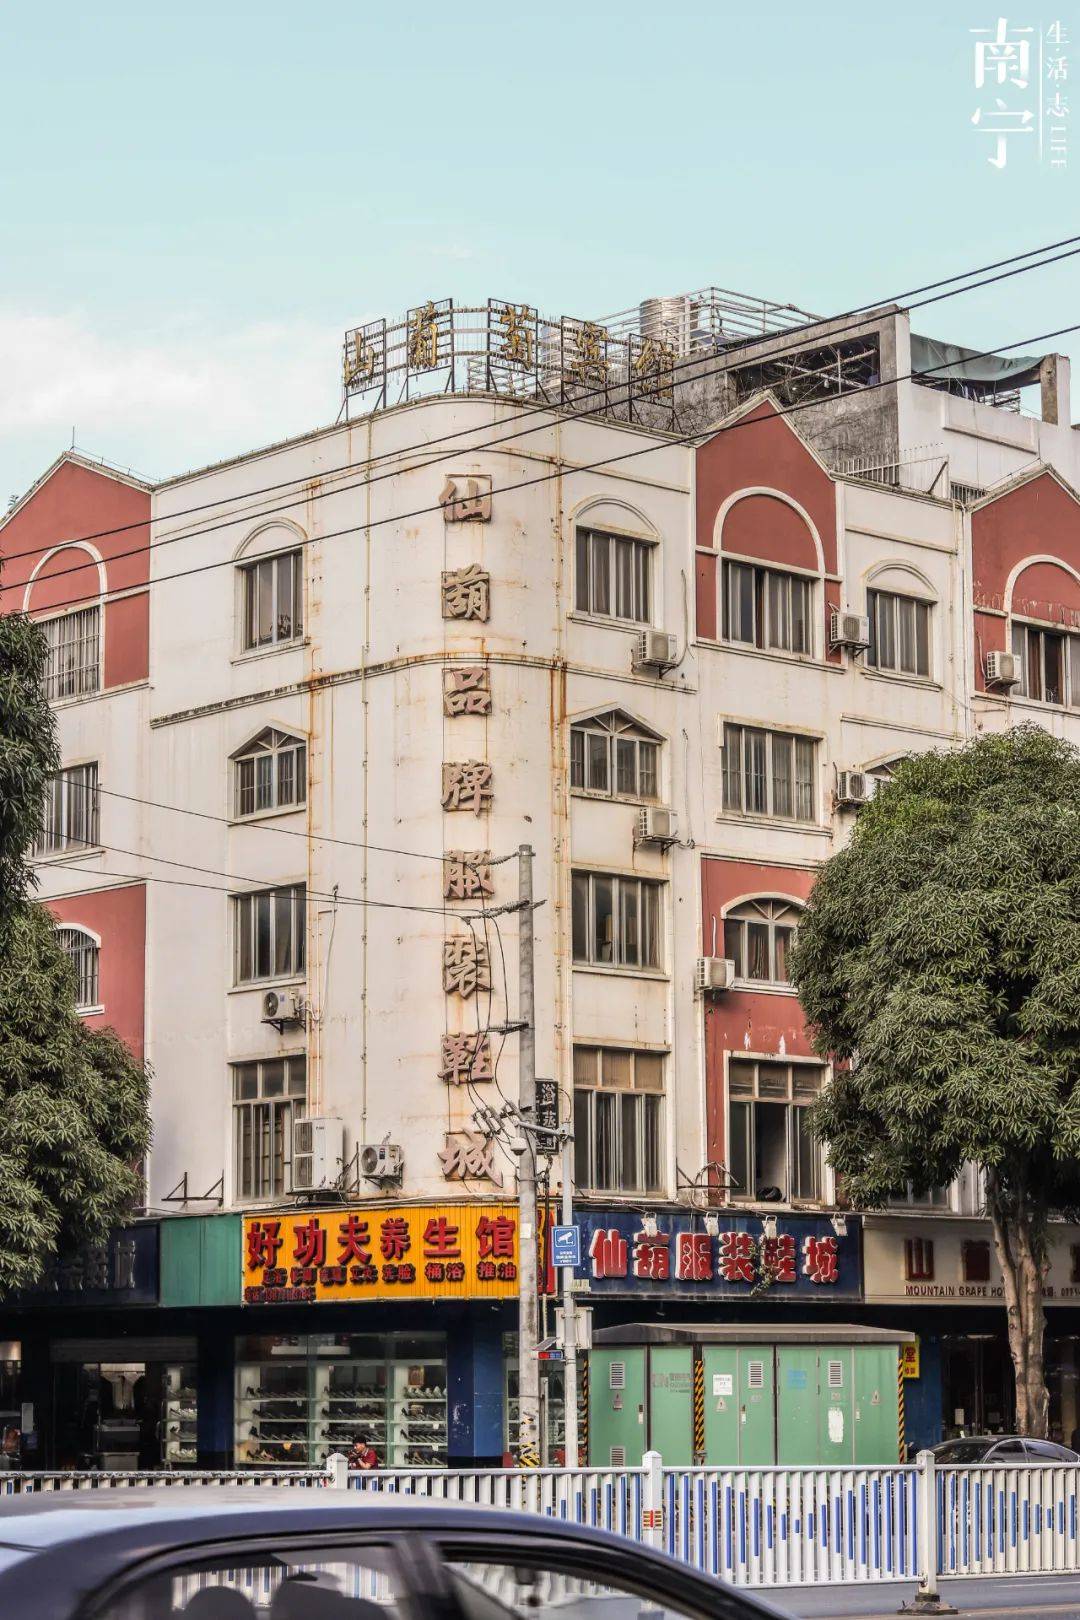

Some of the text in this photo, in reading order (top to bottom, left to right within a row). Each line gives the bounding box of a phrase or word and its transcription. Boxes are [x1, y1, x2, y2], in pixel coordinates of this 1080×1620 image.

[246, 1214, 517, 1272] 好功夫养生馆
[589, 1228, 840, 1284] 仙葫服装鞋城
[425, 1262, 465, 1282] 桶浴
[477, 1261, 517, 1281] 推油
[905, 1285, 955, 1297] MOUNTAIN
[959, 1286, 987, 1297] GRAPE
